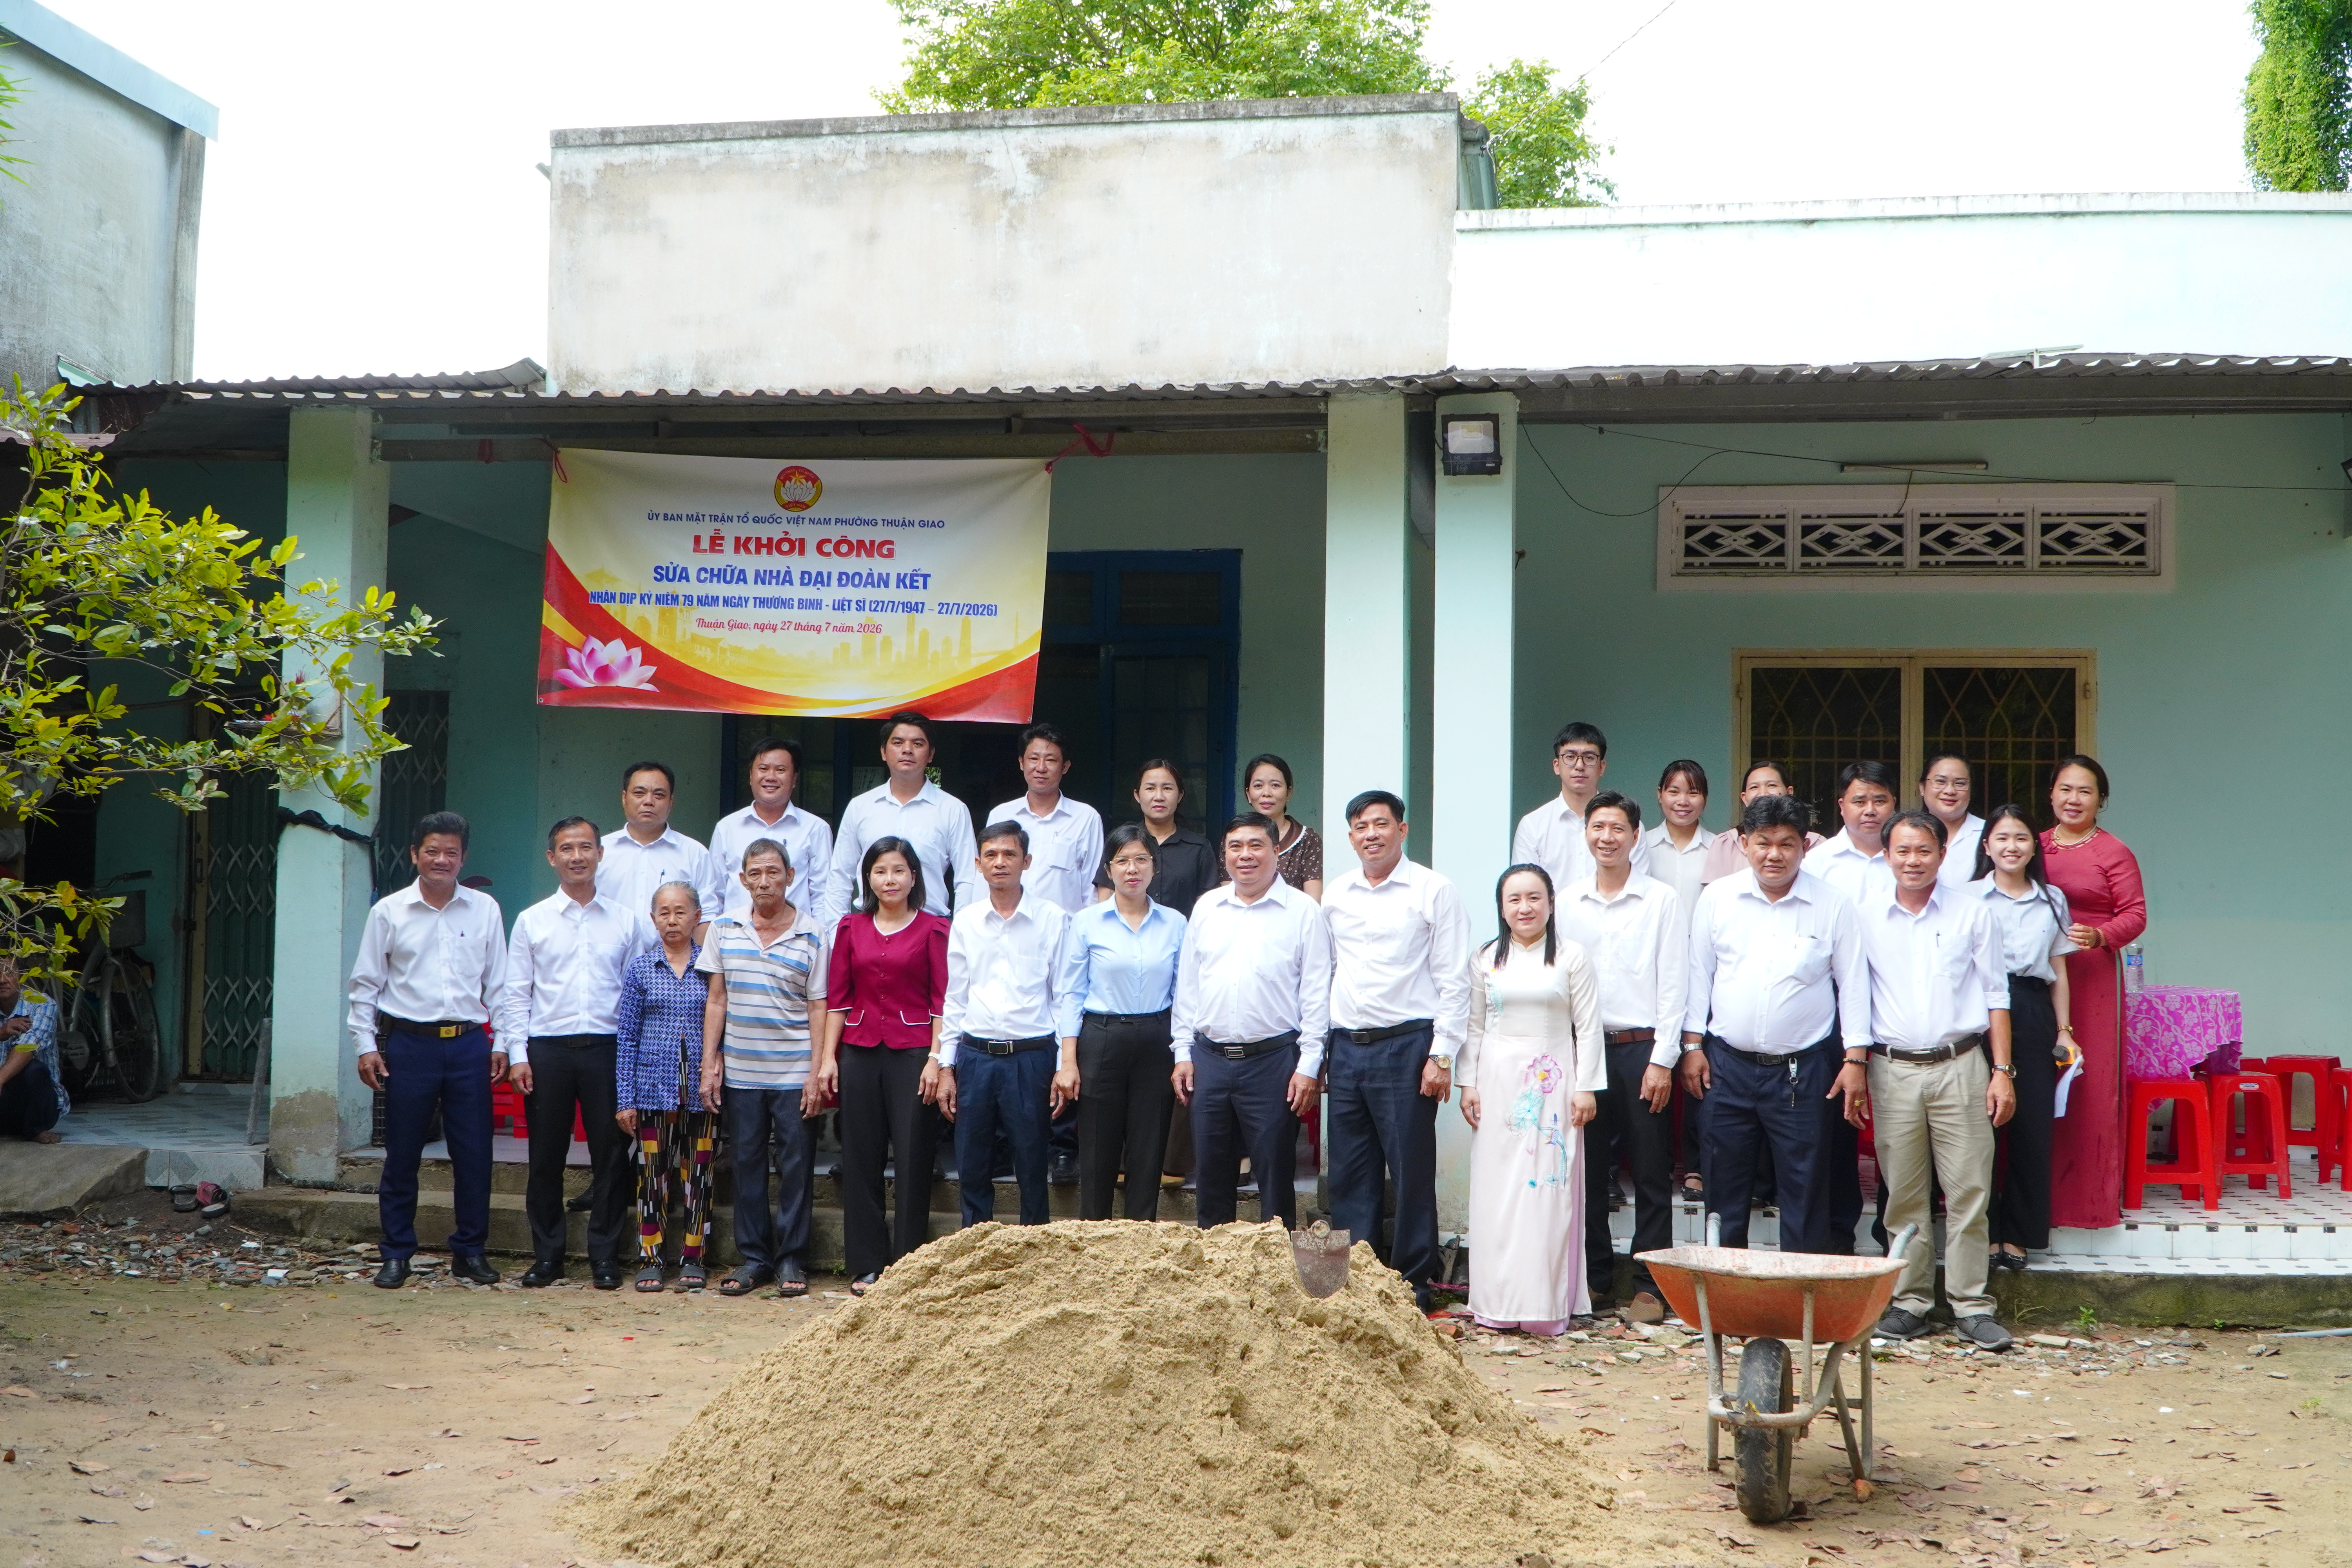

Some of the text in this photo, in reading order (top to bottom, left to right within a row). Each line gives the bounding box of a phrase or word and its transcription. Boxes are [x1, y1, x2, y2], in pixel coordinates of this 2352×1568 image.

[648, 510, 945, 530] ỦY BAN MẶT TRẬN TỔ QUỐC VIỆT NAM PHƯỜNG THUẬN GIAO
[693, 528, 895, 559] LỄ KHỞI CÔNG
[653, 562, 931, 590] SỬA CHỮA NHÀ ĐẠI ĐOÀN KẾT
[590, 590, 617, 604] NHÂN
[619, 593, 637, 606] DỊP
[639, 590, 652, 605] KỶ
[655, 592, 679, 608] NIỆM
[682, 595, 694, 606] 79
[697, 593, 720, 607] NĂM
[722, 594, 750, 608] NGÀY
[753, 596, 795, 610] THƯƠNG
[797, 598, 823, 610] BINH
[832, 597, 853, 613] LIỆT
[855, 598, 866, 612] SĨ
[869, 600, 925, 614] (27/7/1947
[938, 602, 998, 616] 27/7/2026)
[696, 618, 882, 635] Thuận Giao, ngày 27 tháng 7 năm 2026
